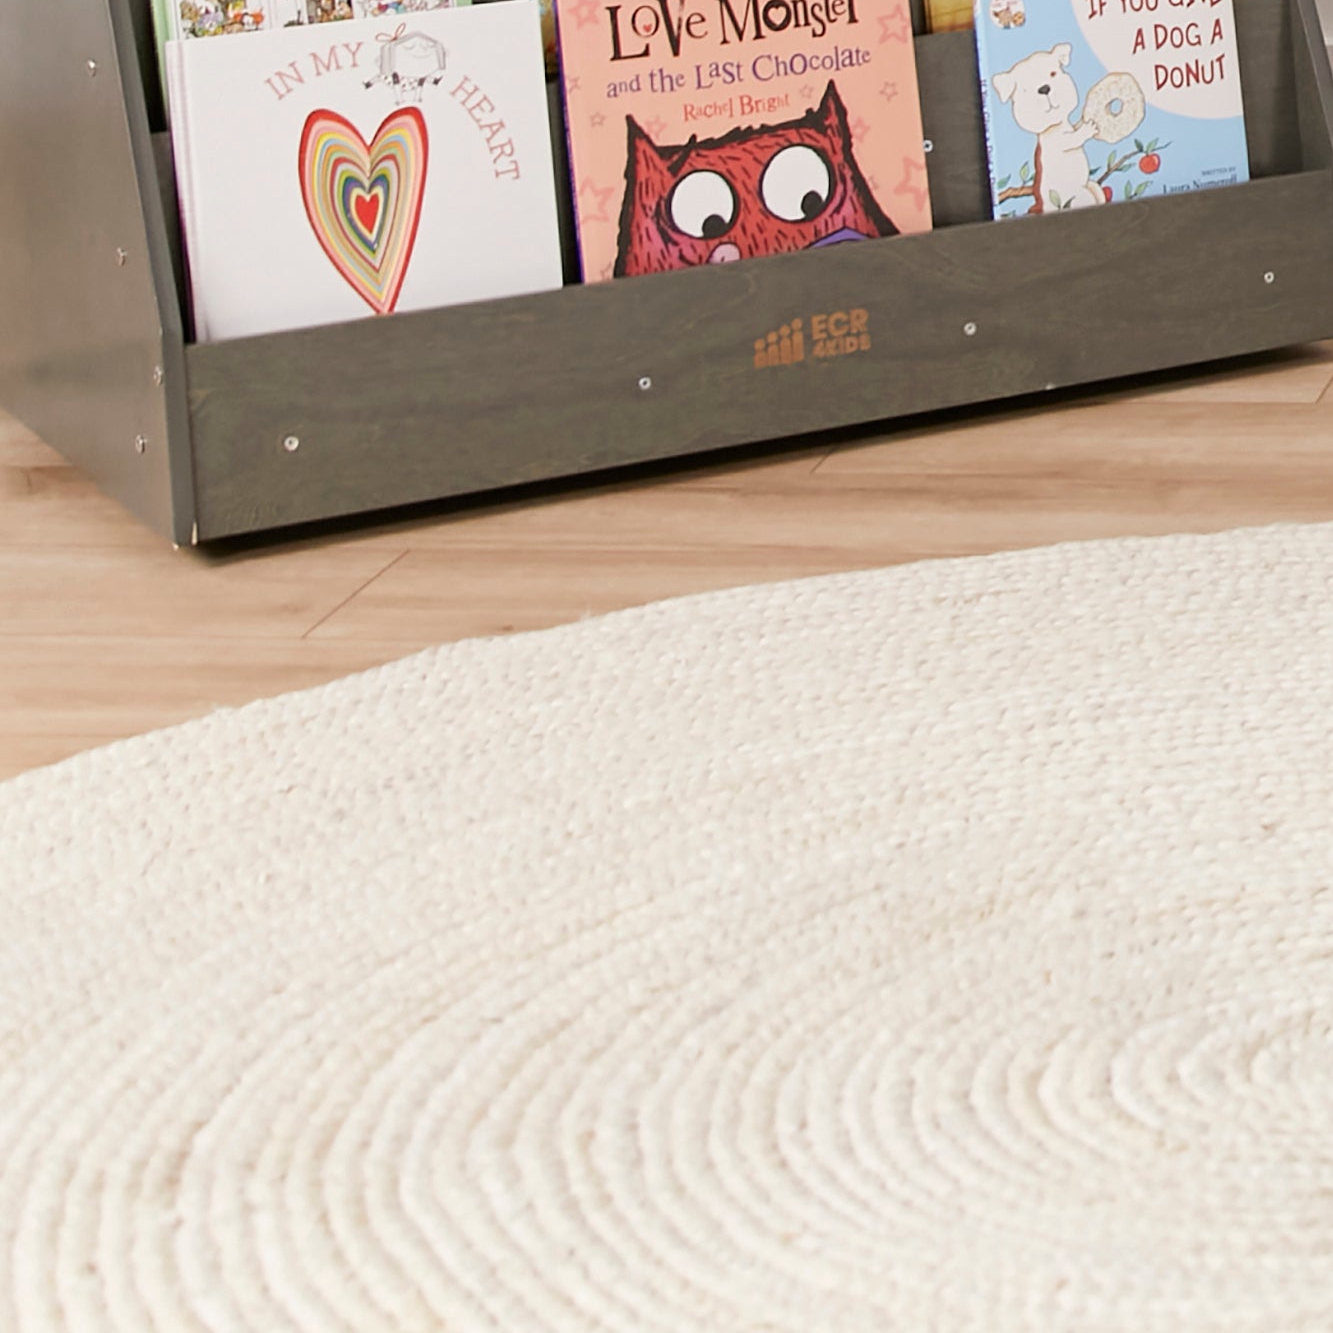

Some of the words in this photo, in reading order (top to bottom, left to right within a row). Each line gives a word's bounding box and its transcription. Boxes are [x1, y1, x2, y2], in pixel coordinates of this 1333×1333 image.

[1132, 27, 1147, 55] A
[1154, 22, 1202, 50] DOG
[1210, 18, 1225, 45] A
[264, 61, 305, 101] IN
[309, 42, 365, 78] MY
[606, 74, 642, 99] and
[649, 67, 686, 92] the
[695, 61, 744, 90] Last
[752, 46, 871, 82] Chocolate
[1154, 53, 1227, 91] DONUT
[684, 101, 734, 123] Rachel
[739, 93, 790, 117] Bright
[449, 74, 522, 182] HEART
[811, 308, 869, 341] ECR
